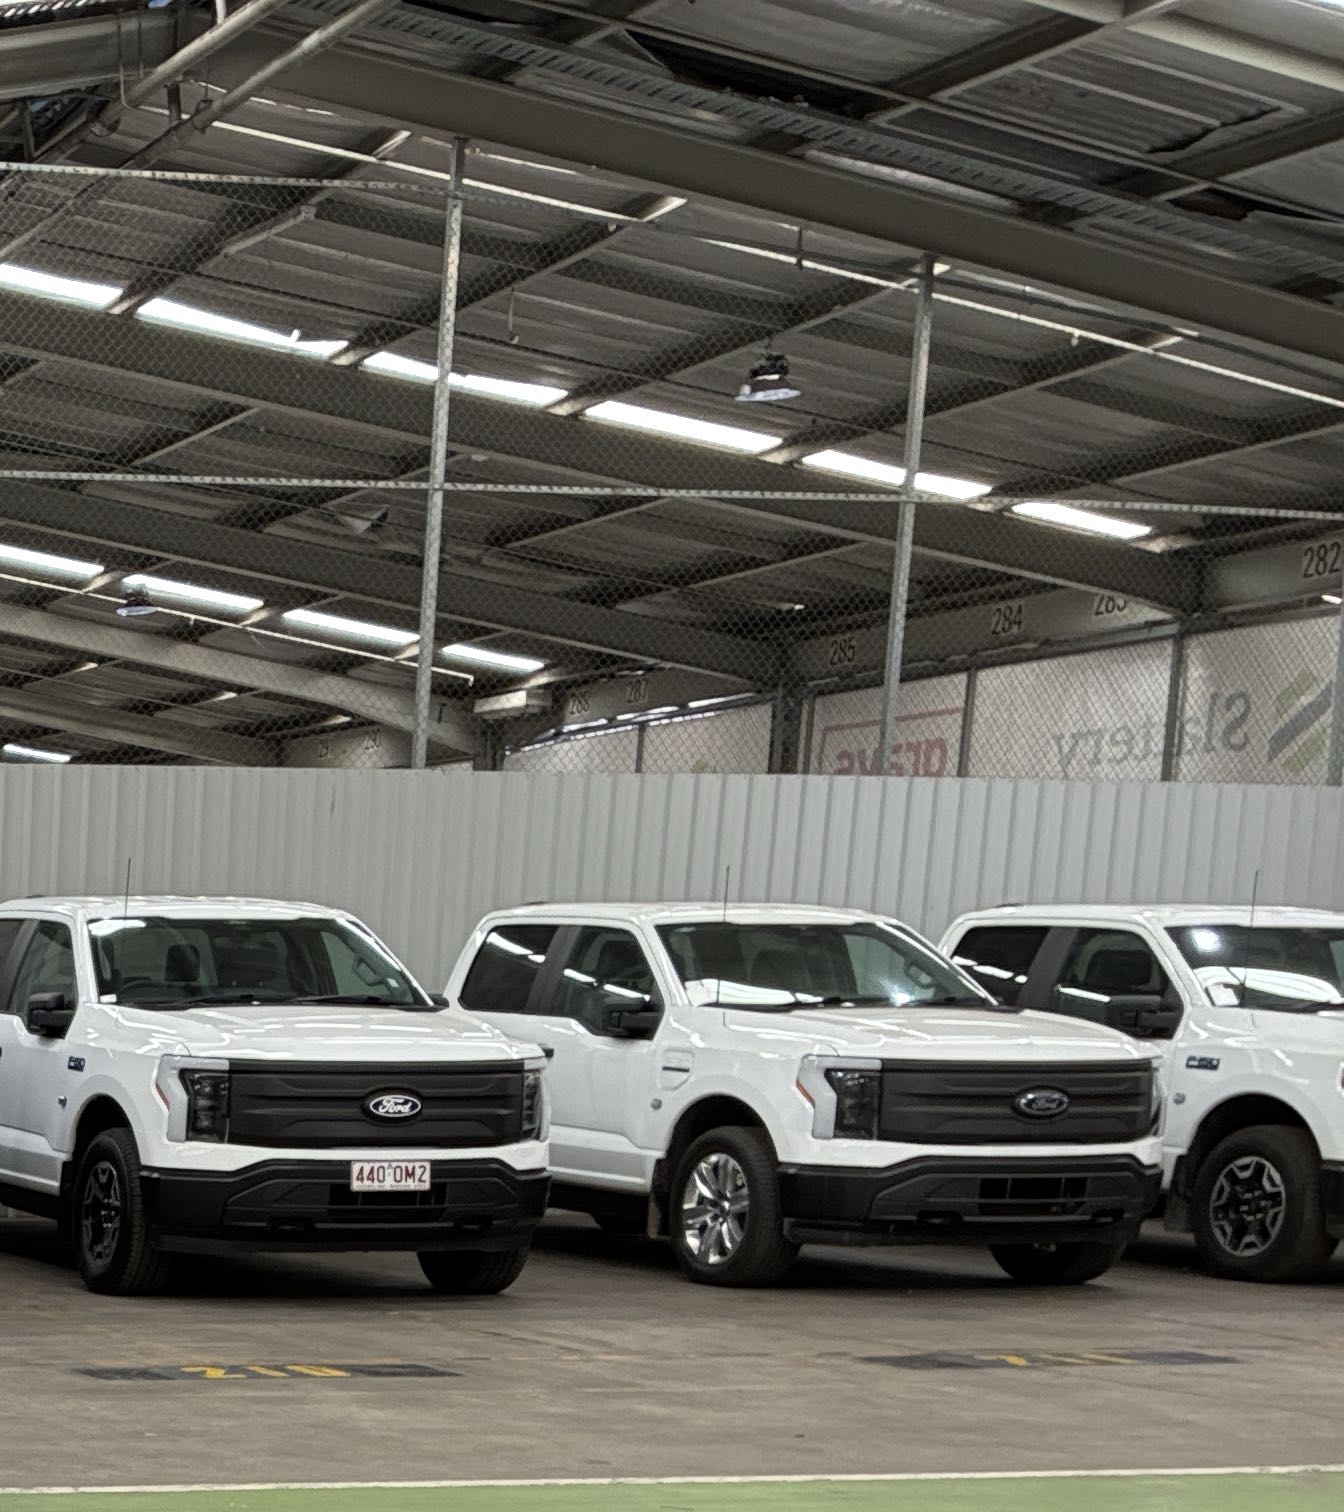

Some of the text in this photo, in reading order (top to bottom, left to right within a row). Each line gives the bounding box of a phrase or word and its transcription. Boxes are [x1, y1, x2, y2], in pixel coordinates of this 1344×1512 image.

[1303, 541, 1341, 578] 282
[991, 604, 1023, 636] 284
[829, 636, 856, 665] 285
[377, 1097, 414, 1114] Ford
